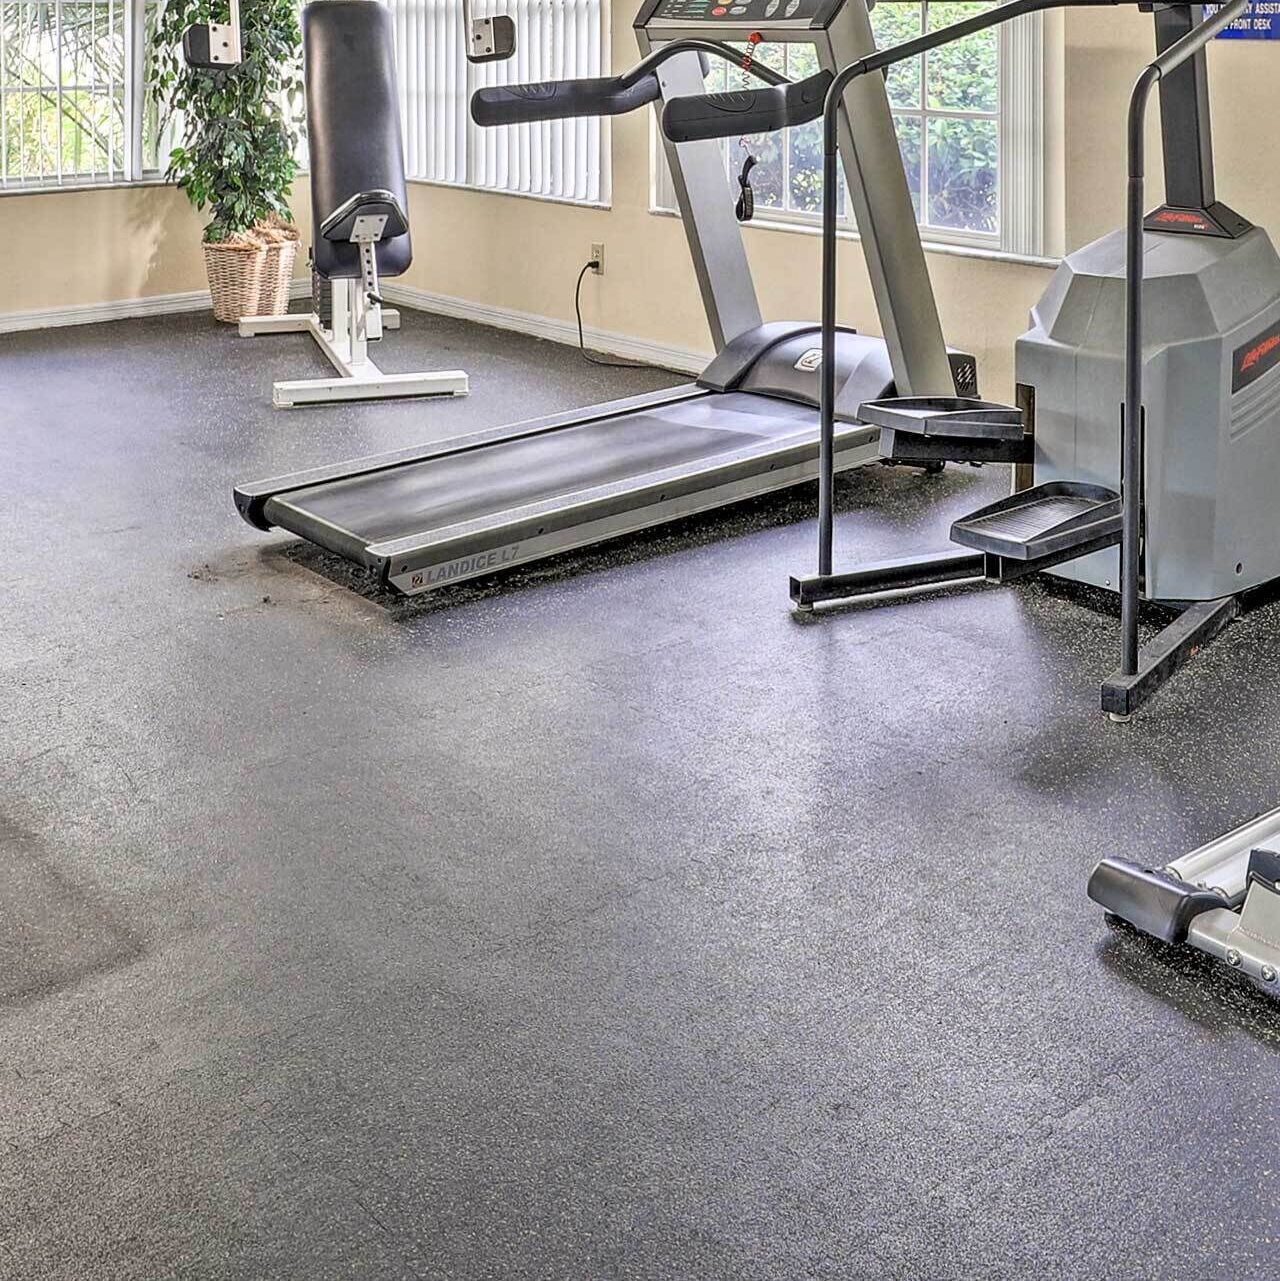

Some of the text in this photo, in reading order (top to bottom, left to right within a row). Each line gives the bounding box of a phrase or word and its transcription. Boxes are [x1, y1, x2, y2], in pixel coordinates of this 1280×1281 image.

[1253, 18, 1272, 30] DESK
[424, 544, 520, 584] LANDICE L7
